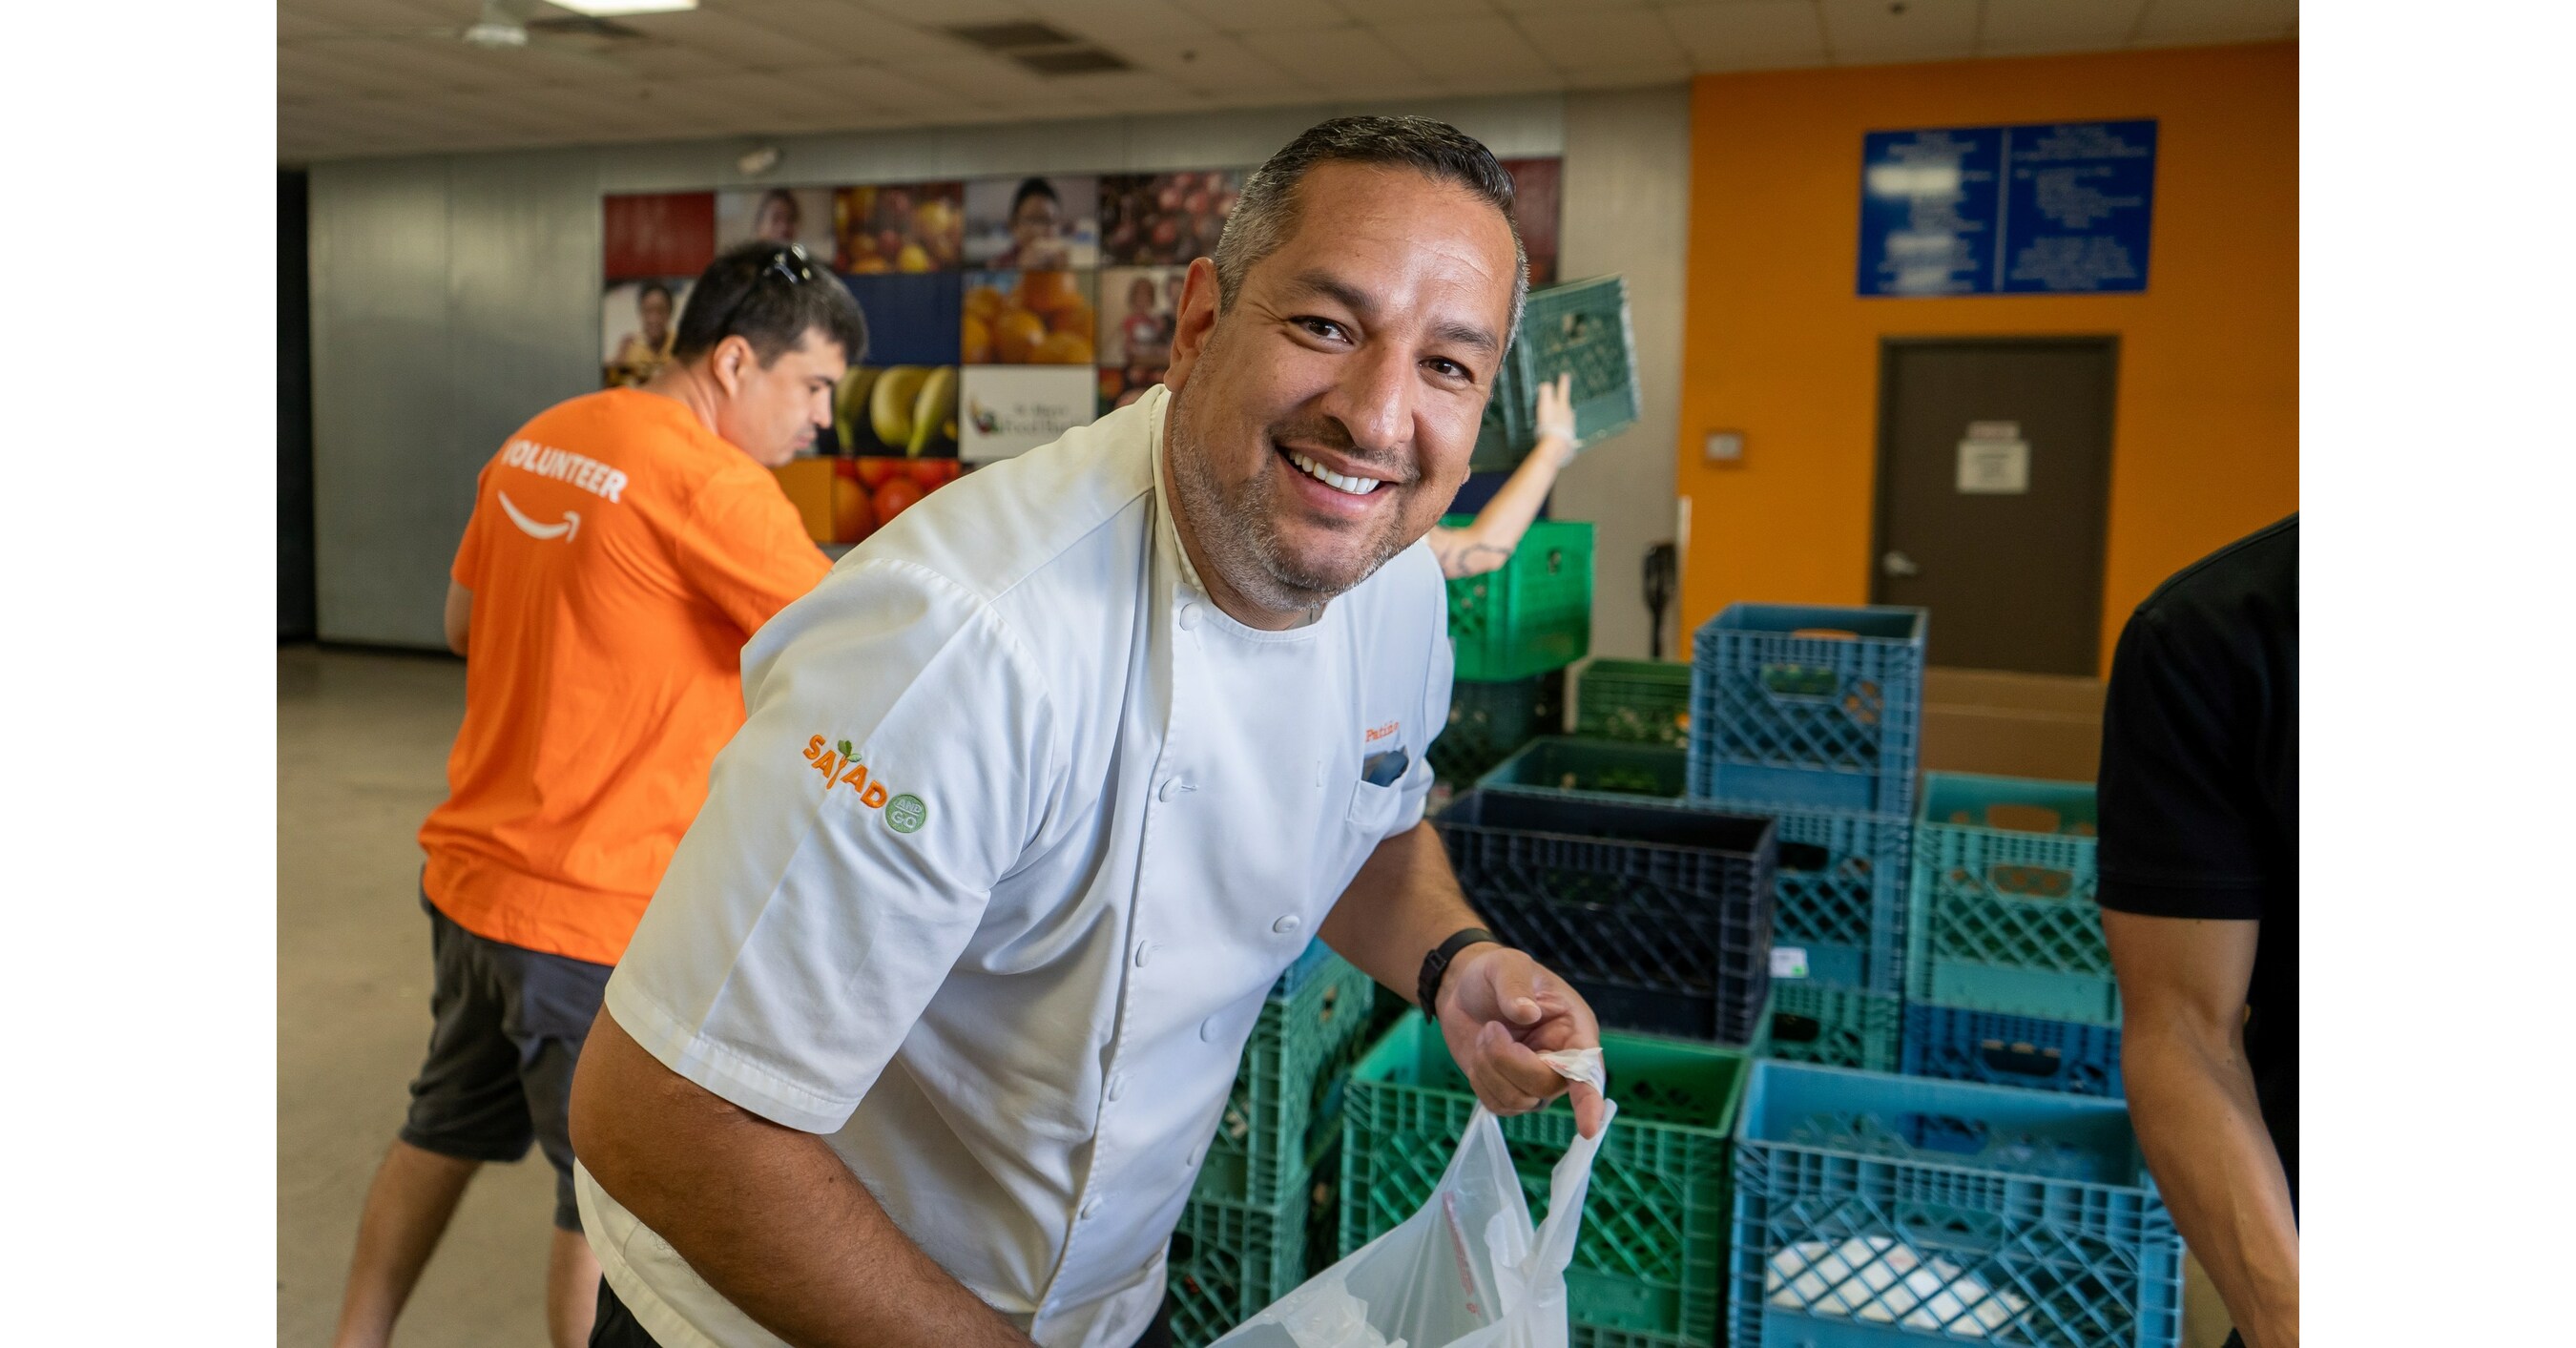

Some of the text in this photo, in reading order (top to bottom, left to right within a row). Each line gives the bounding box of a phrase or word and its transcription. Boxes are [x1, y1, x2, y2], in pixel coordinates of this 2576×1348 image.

[500, 440, 629, 504] VOLUNTEER
[894, 798, 923, 814] AND
[891, 810, 918, 829] GO
